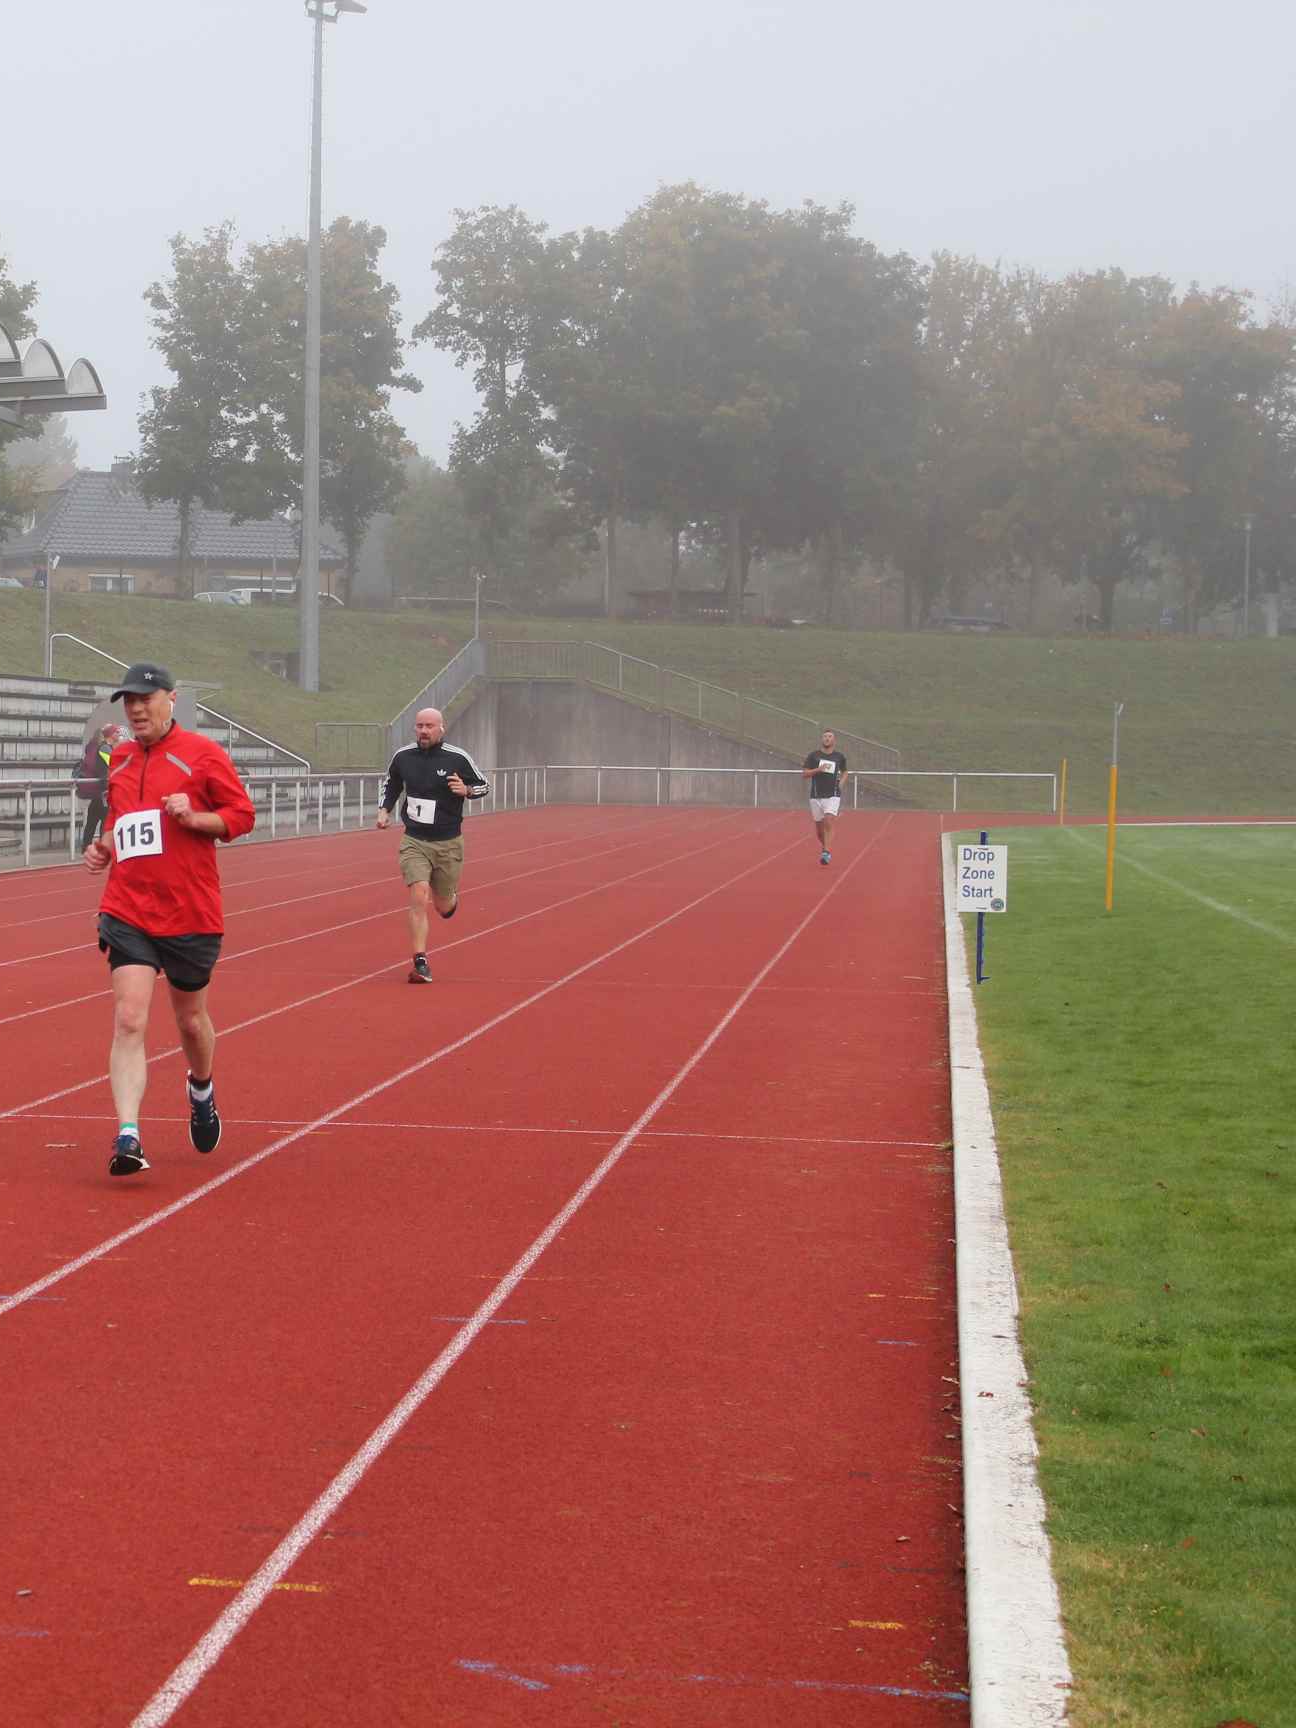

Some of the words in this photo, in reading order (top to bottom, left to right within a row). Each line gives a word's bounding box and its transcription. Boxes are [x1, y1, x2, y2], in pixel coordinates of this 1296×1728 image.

[416, 804, 422, 817] 1
[117, 821, 154, 851] 115
[963, 848, 995, 864] Drop
[962, 867, 995, 879] Zone
[962, 885, 993, 897] Start
